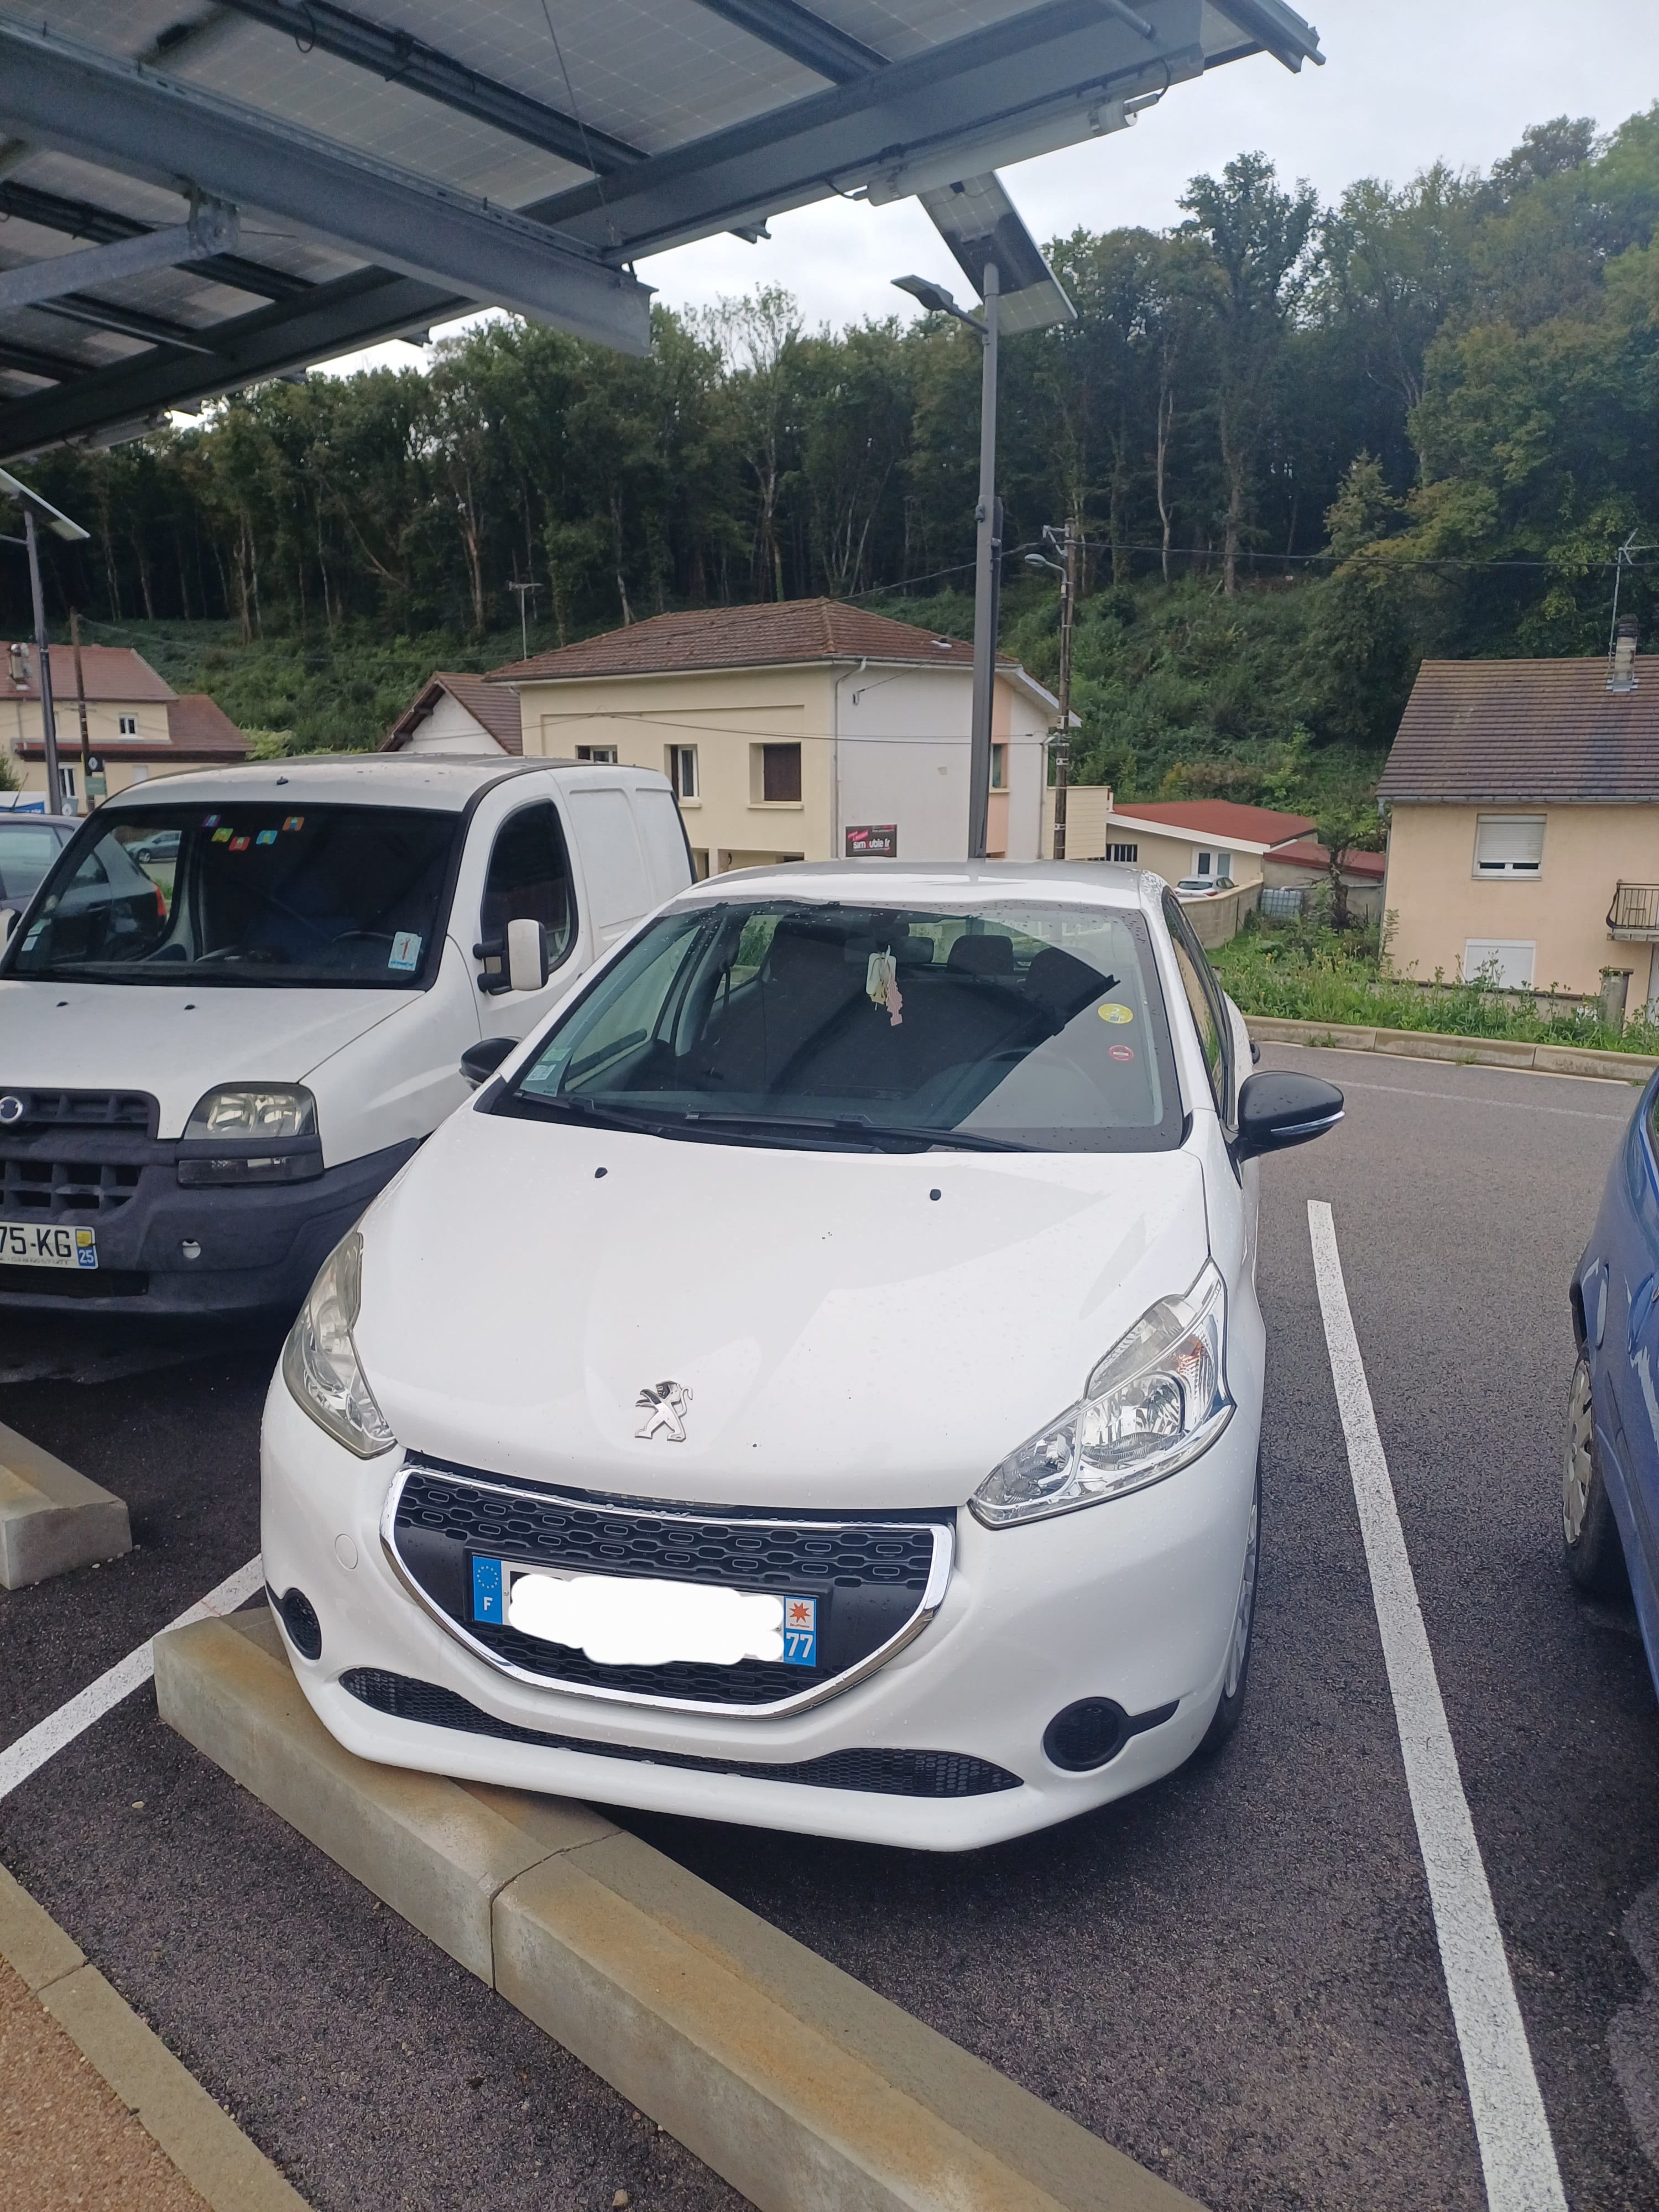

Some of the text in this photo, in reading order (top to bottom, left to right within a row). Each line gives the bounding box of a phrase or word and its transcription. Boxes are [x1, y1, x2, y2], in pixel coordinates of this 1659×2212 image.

[79, 1249, 94, 1264] 25
[483, 1597, 493, 1611] F
[786, 1632, 813, 1658] 77
